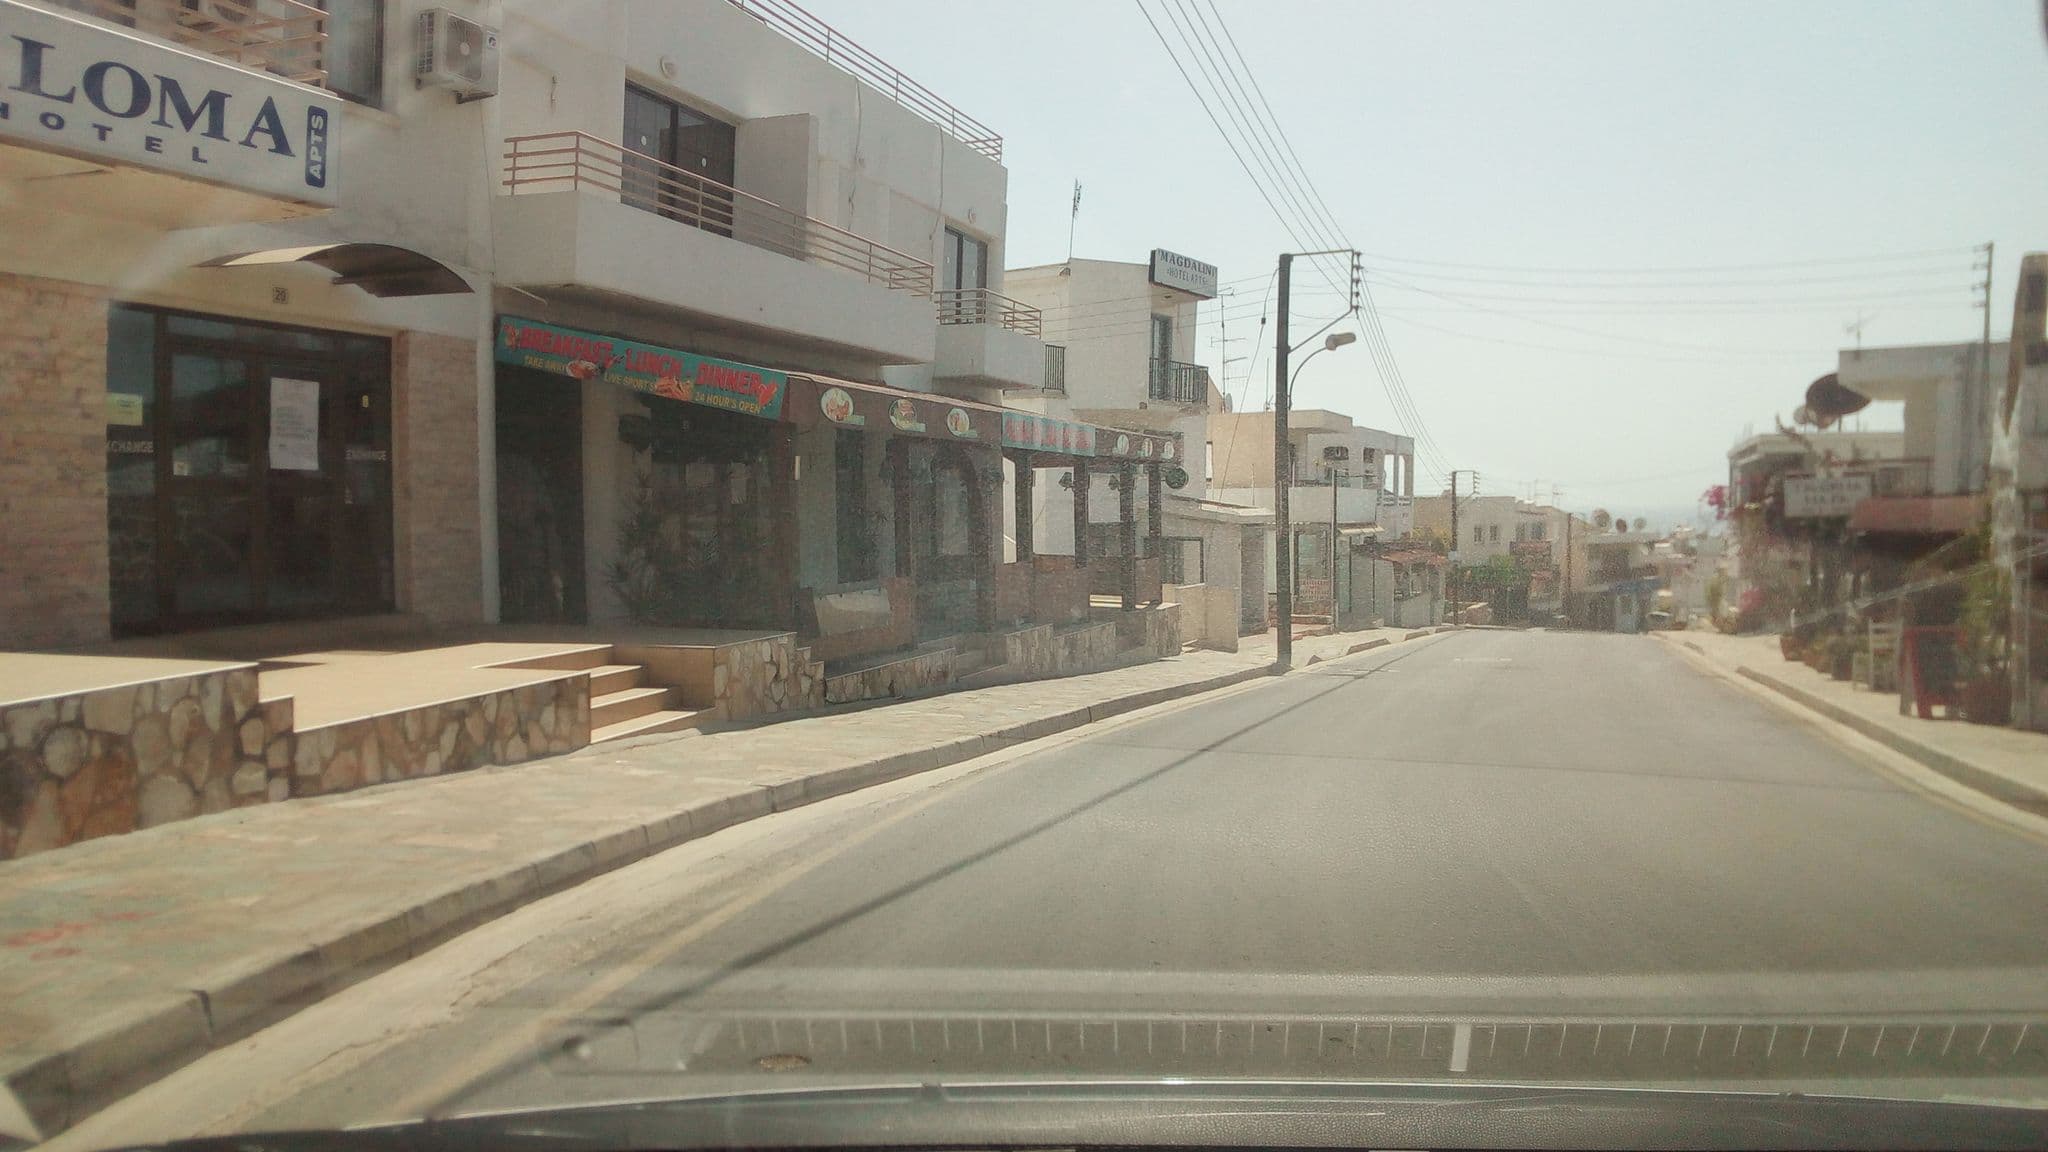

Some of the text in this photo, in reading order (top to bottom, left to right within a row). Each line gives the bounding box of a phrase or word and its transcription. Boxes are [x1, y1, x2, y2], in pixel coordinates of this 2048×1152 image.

[309, 114, 324, 180] APTS
[625, 347, 684, 378] LUNCH
[694, 361, 763, 397] DINNER
[738, 401, 761, 415] OPEN
